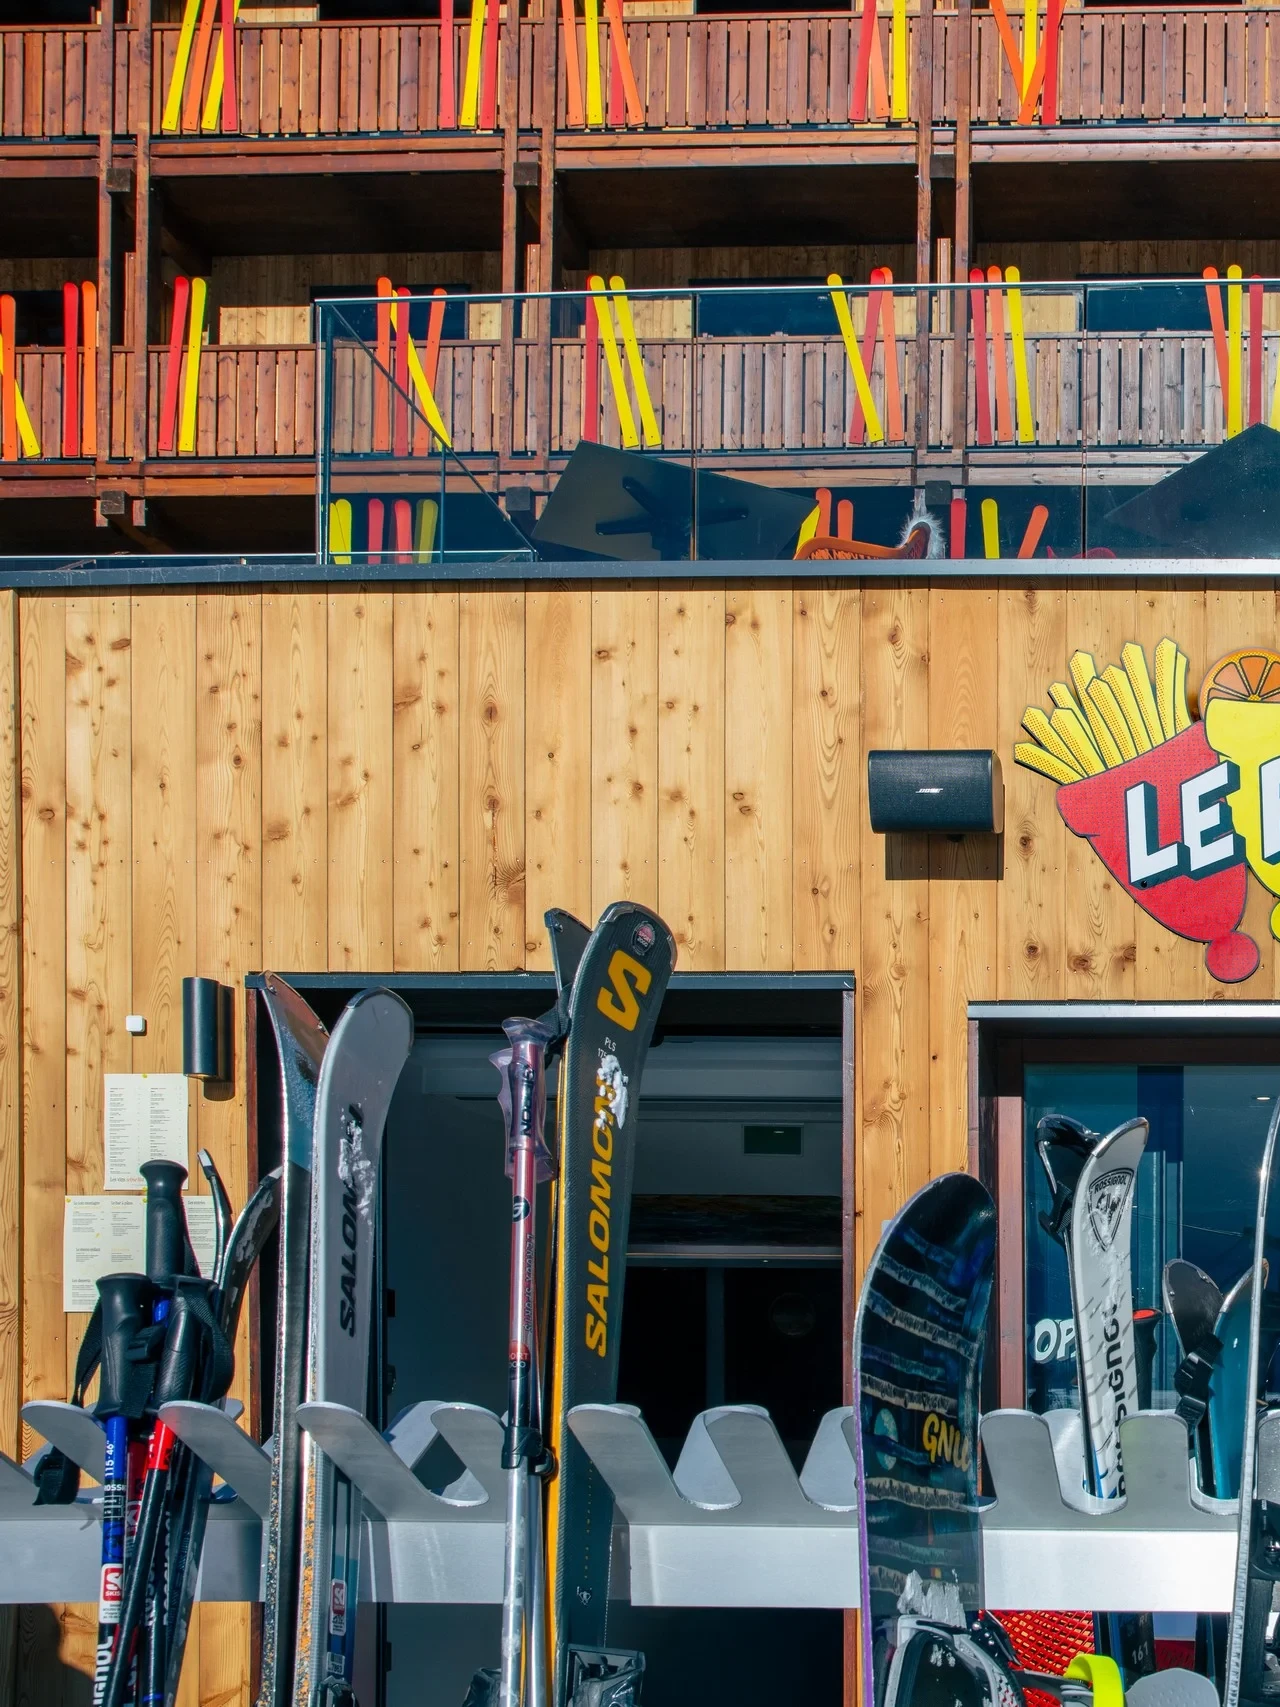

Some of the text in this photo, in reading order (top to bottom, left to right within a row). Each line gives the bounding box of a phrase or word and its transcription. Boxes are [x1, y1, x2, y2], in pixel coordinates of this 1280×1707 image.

[1125, 761, 1246, 886] LE
[1094, 1174, 1128, 1194] ROSSIGNOL
[923, 1413, 971, 1472] GNU
[1132, 1640, 1149, 1665] 161
